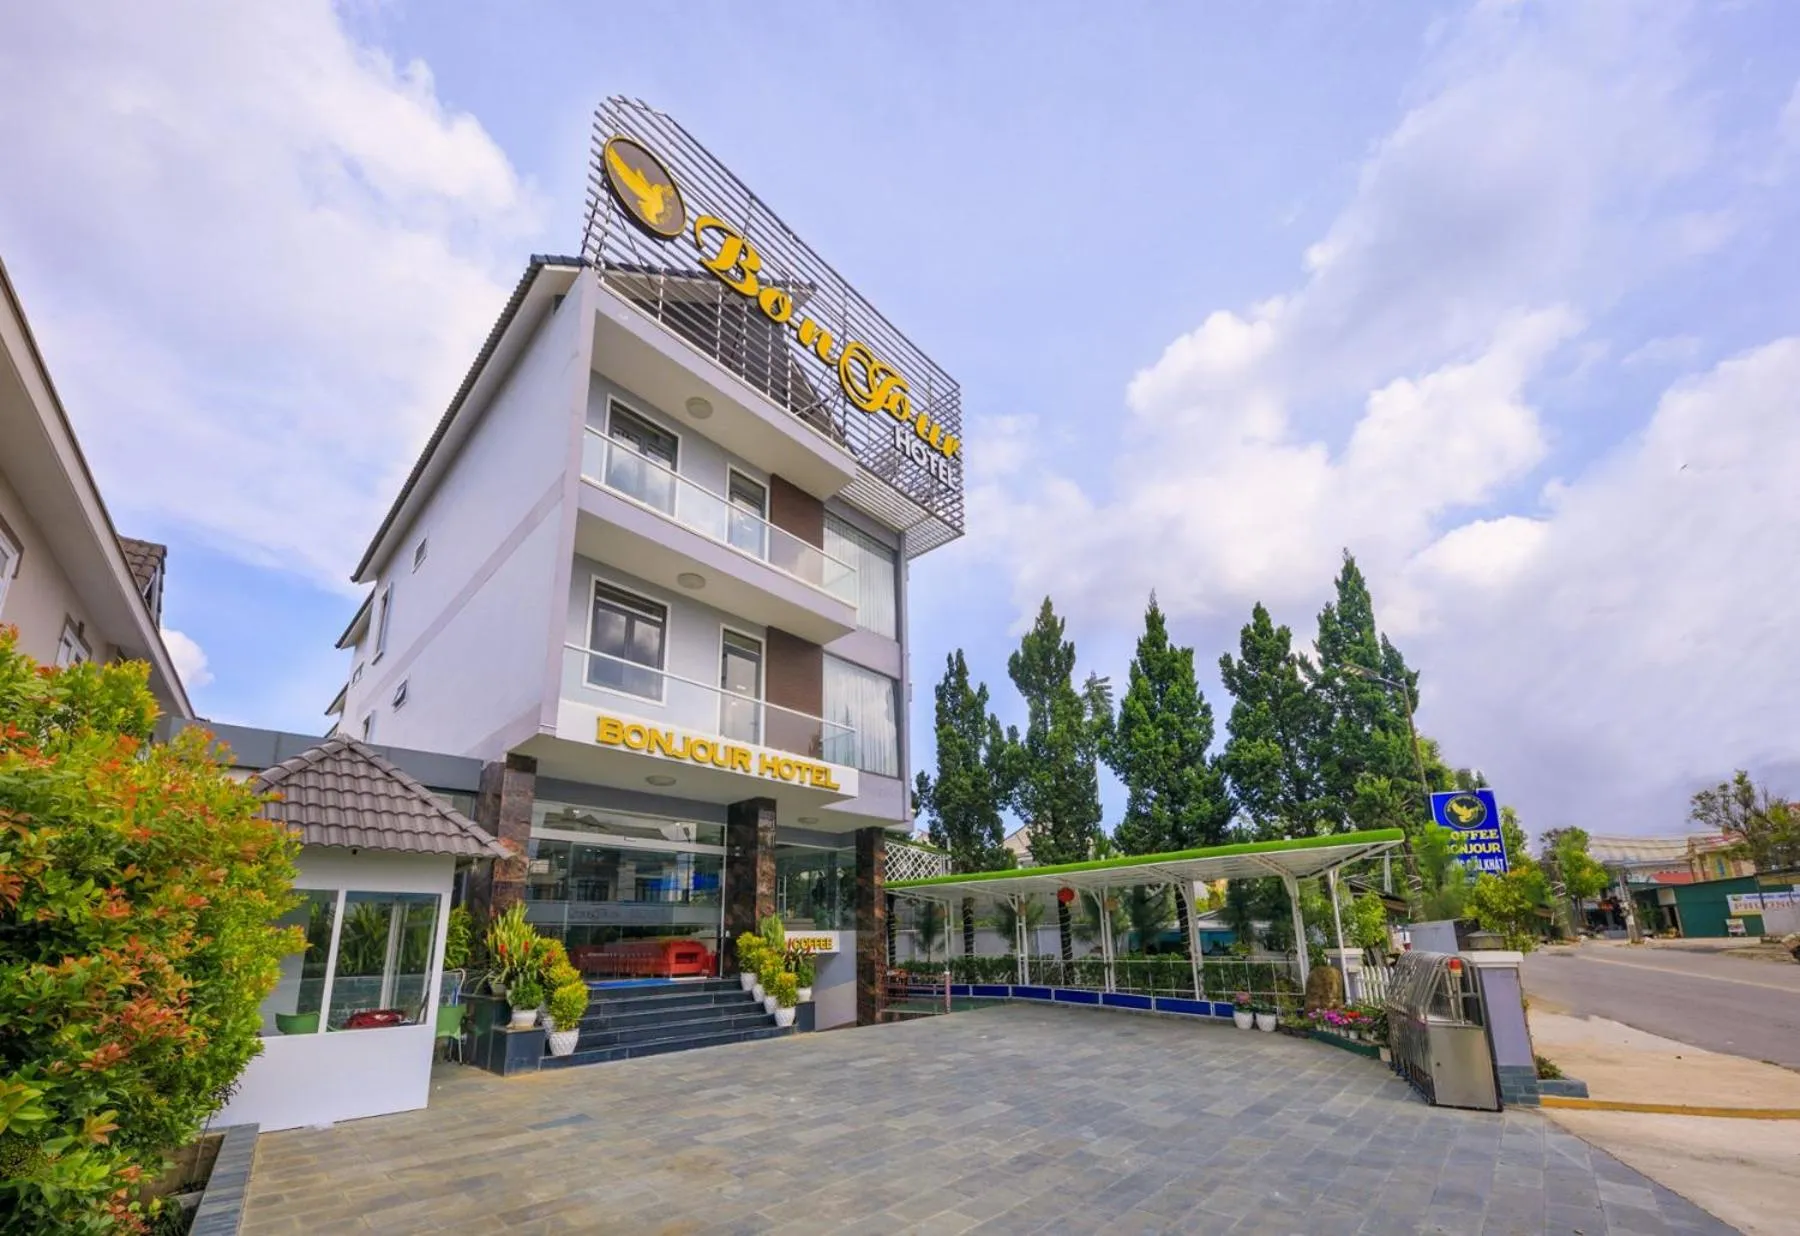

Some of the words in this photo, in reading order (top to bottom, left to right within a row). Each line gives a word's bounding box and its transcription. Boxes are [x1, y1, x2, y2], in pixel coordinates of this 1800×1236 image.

[893, 425, 958, 493] HOTEL
[596, 716, 753, 773] BONJOUR
[758, 751, 840, 791] HOTEL
[791, 937, 834, 950] COFFEE
